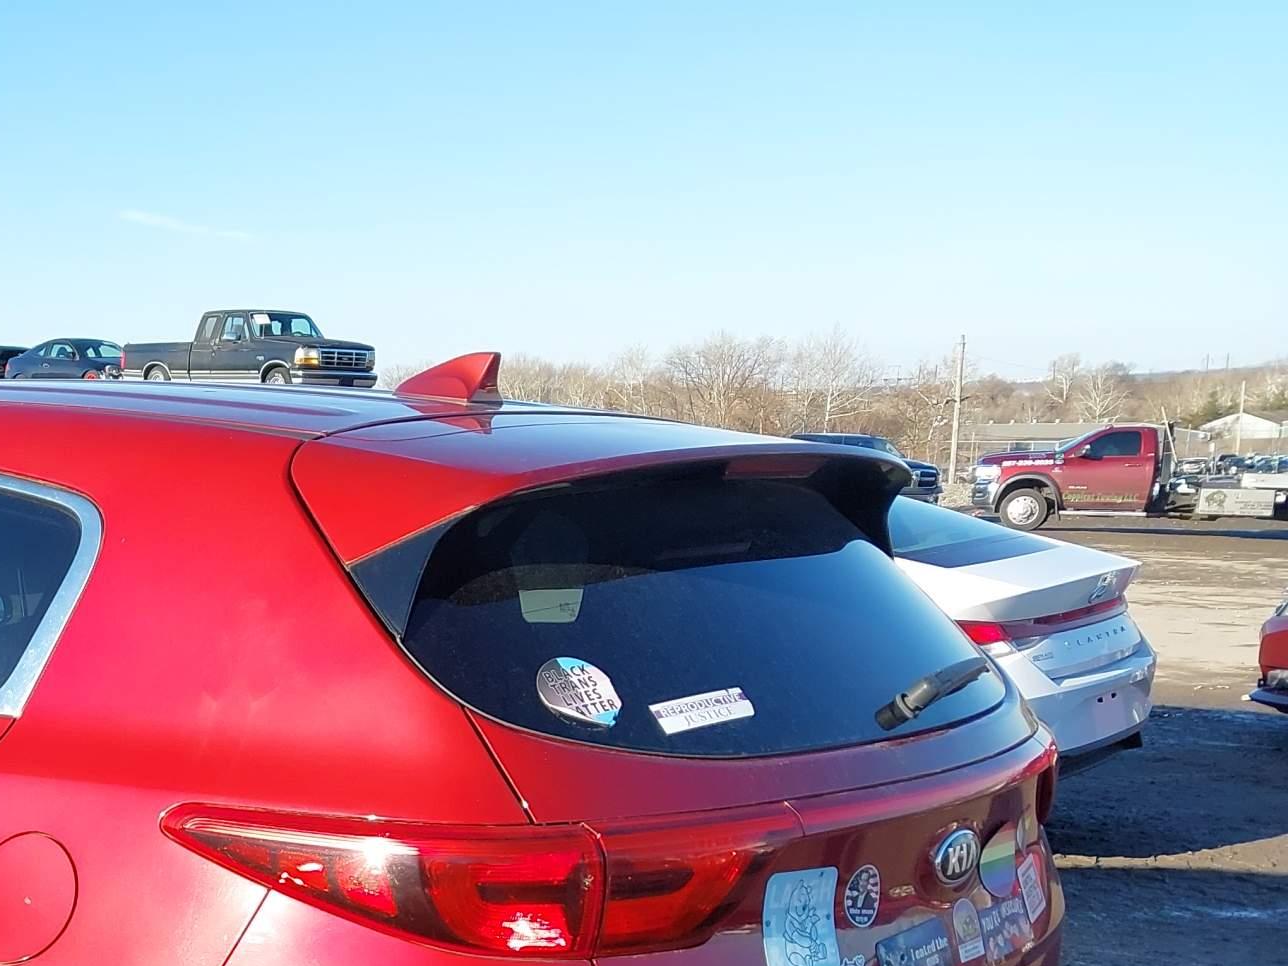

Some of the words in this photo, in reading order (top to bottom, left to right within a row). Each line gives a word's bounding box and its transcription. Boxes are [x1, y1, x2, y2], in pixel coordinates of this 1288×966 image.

[543, 664, 591, 684] BLACK
[550, 676, 598, 695] TRANS
[562, 688, 602, 706] LIVES
[661, 692, 741, 718] REPRODUCTIVE
[573, 699, 618, 717] ATTER
[684, 705, 736, 726] JUSTICE
[946, 840, 978, 875] KIA
[935, 936, 949, 950] the
